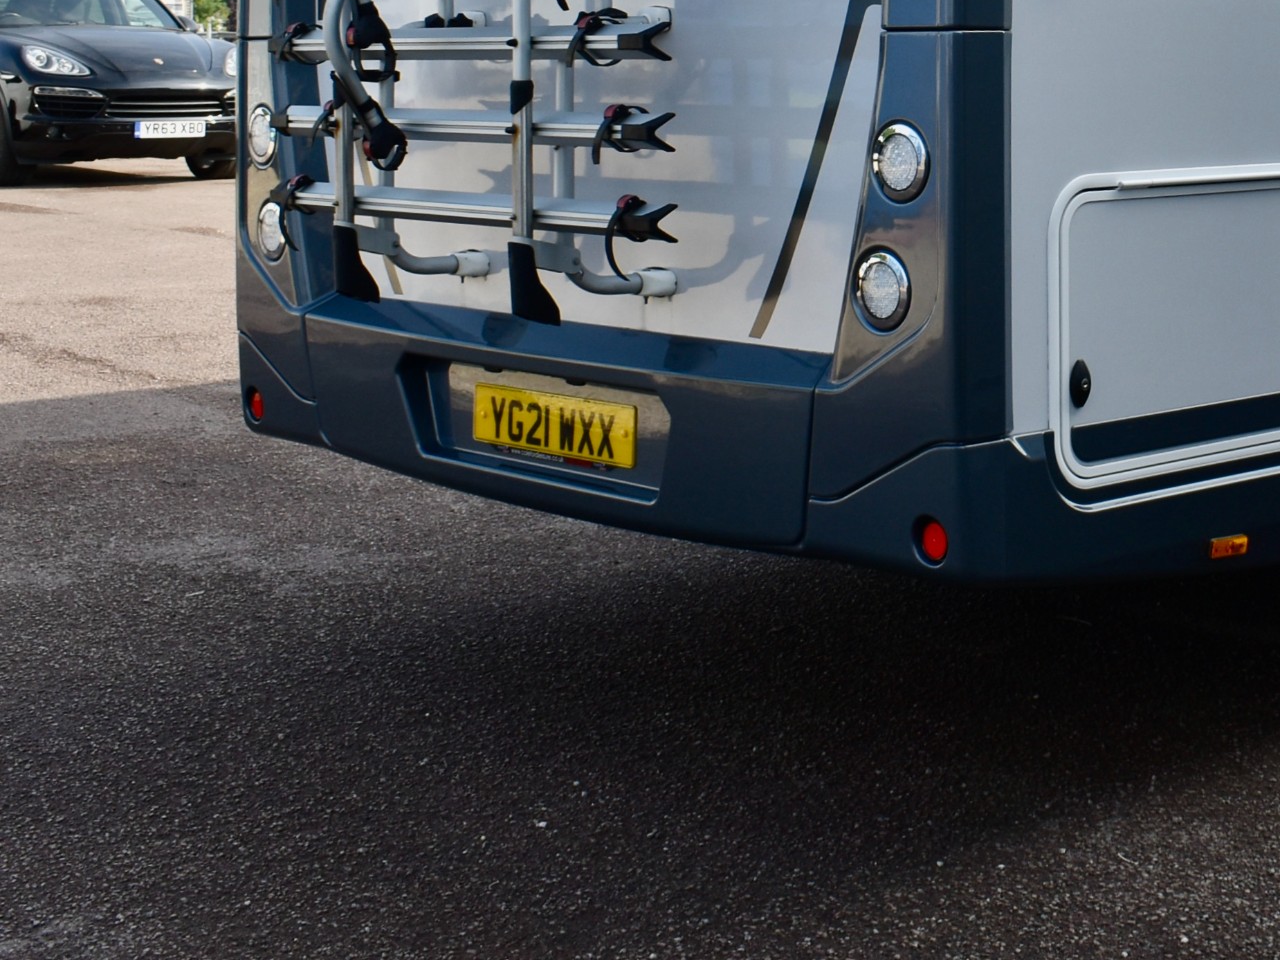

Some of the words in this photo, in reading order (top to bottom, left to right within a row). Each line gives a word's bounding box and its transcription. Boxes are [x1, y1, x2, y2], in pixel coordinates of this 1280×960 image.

[144, 122, 177, 135] YR63
[491, 396, 549, 448] YG21
[559, 407, 615, 459] WXX
